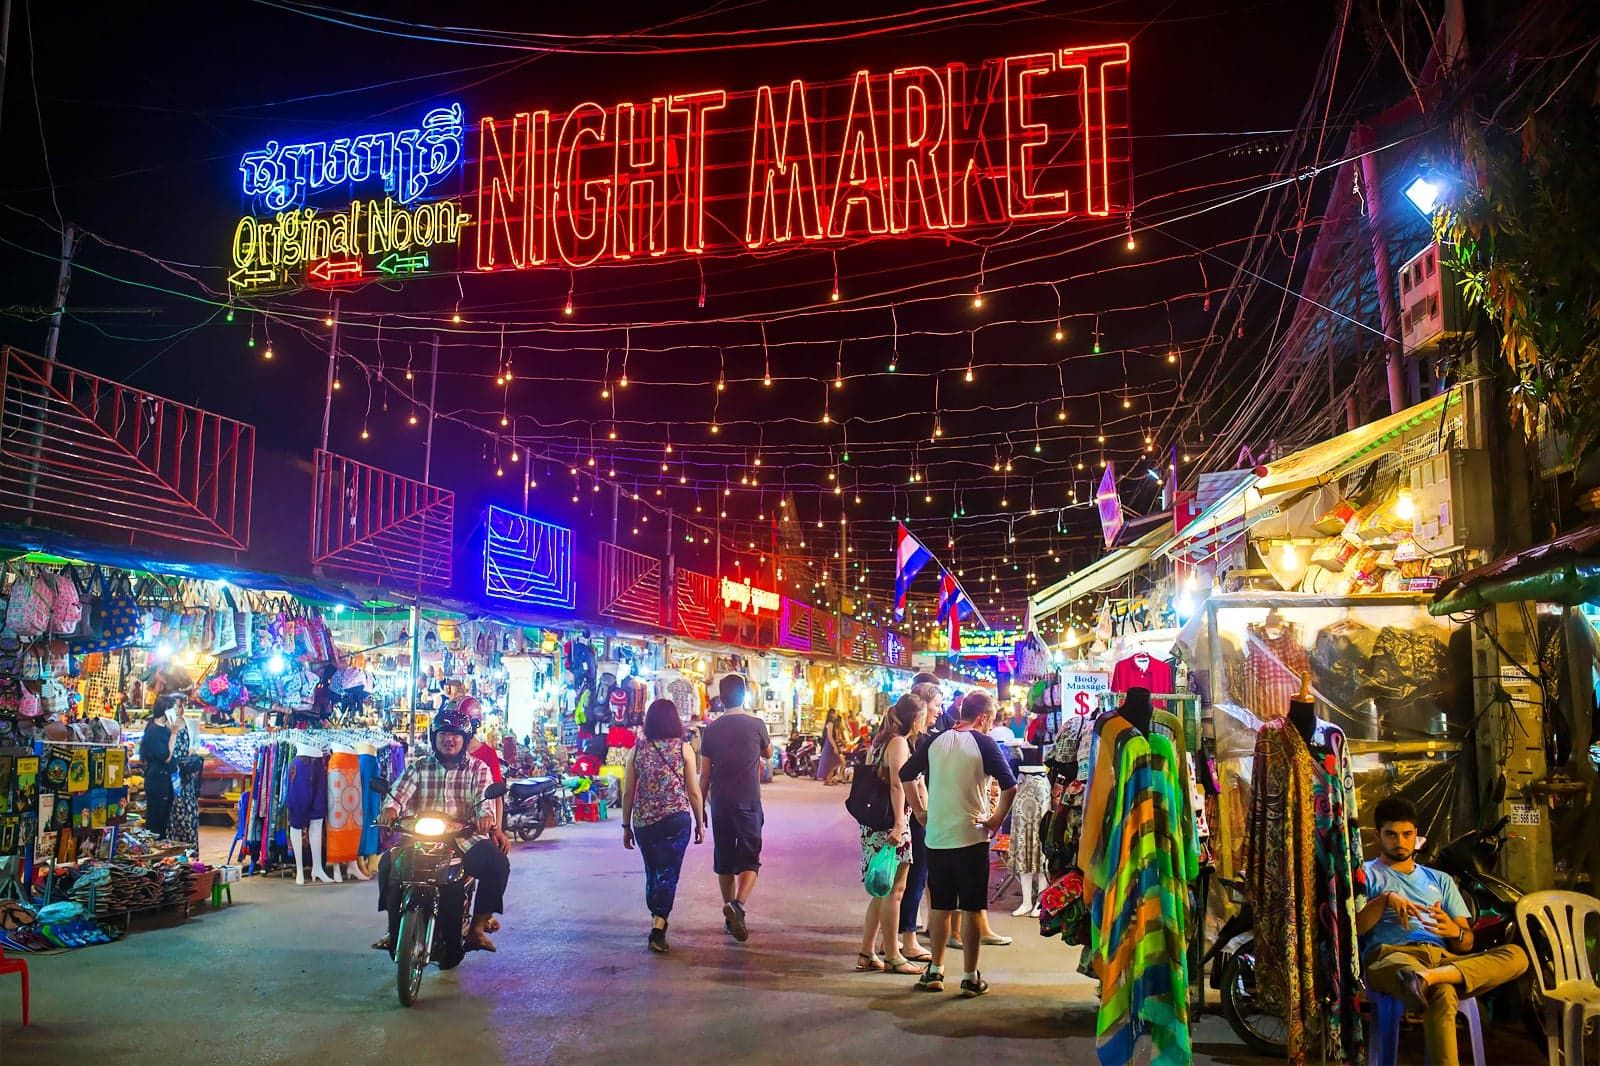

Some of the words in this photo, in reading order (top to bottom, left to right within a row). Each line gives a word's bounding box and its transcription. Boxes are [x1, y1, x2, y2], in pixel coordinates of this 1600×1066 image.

[477, 90, 727, 271] NIGHT
[746, 42, 1131, 249] MARKET
[232, 200, 361, 269] Original
[1066, 683, 1106, 691] Massage
[1074, 675, 1098, 684] Body
